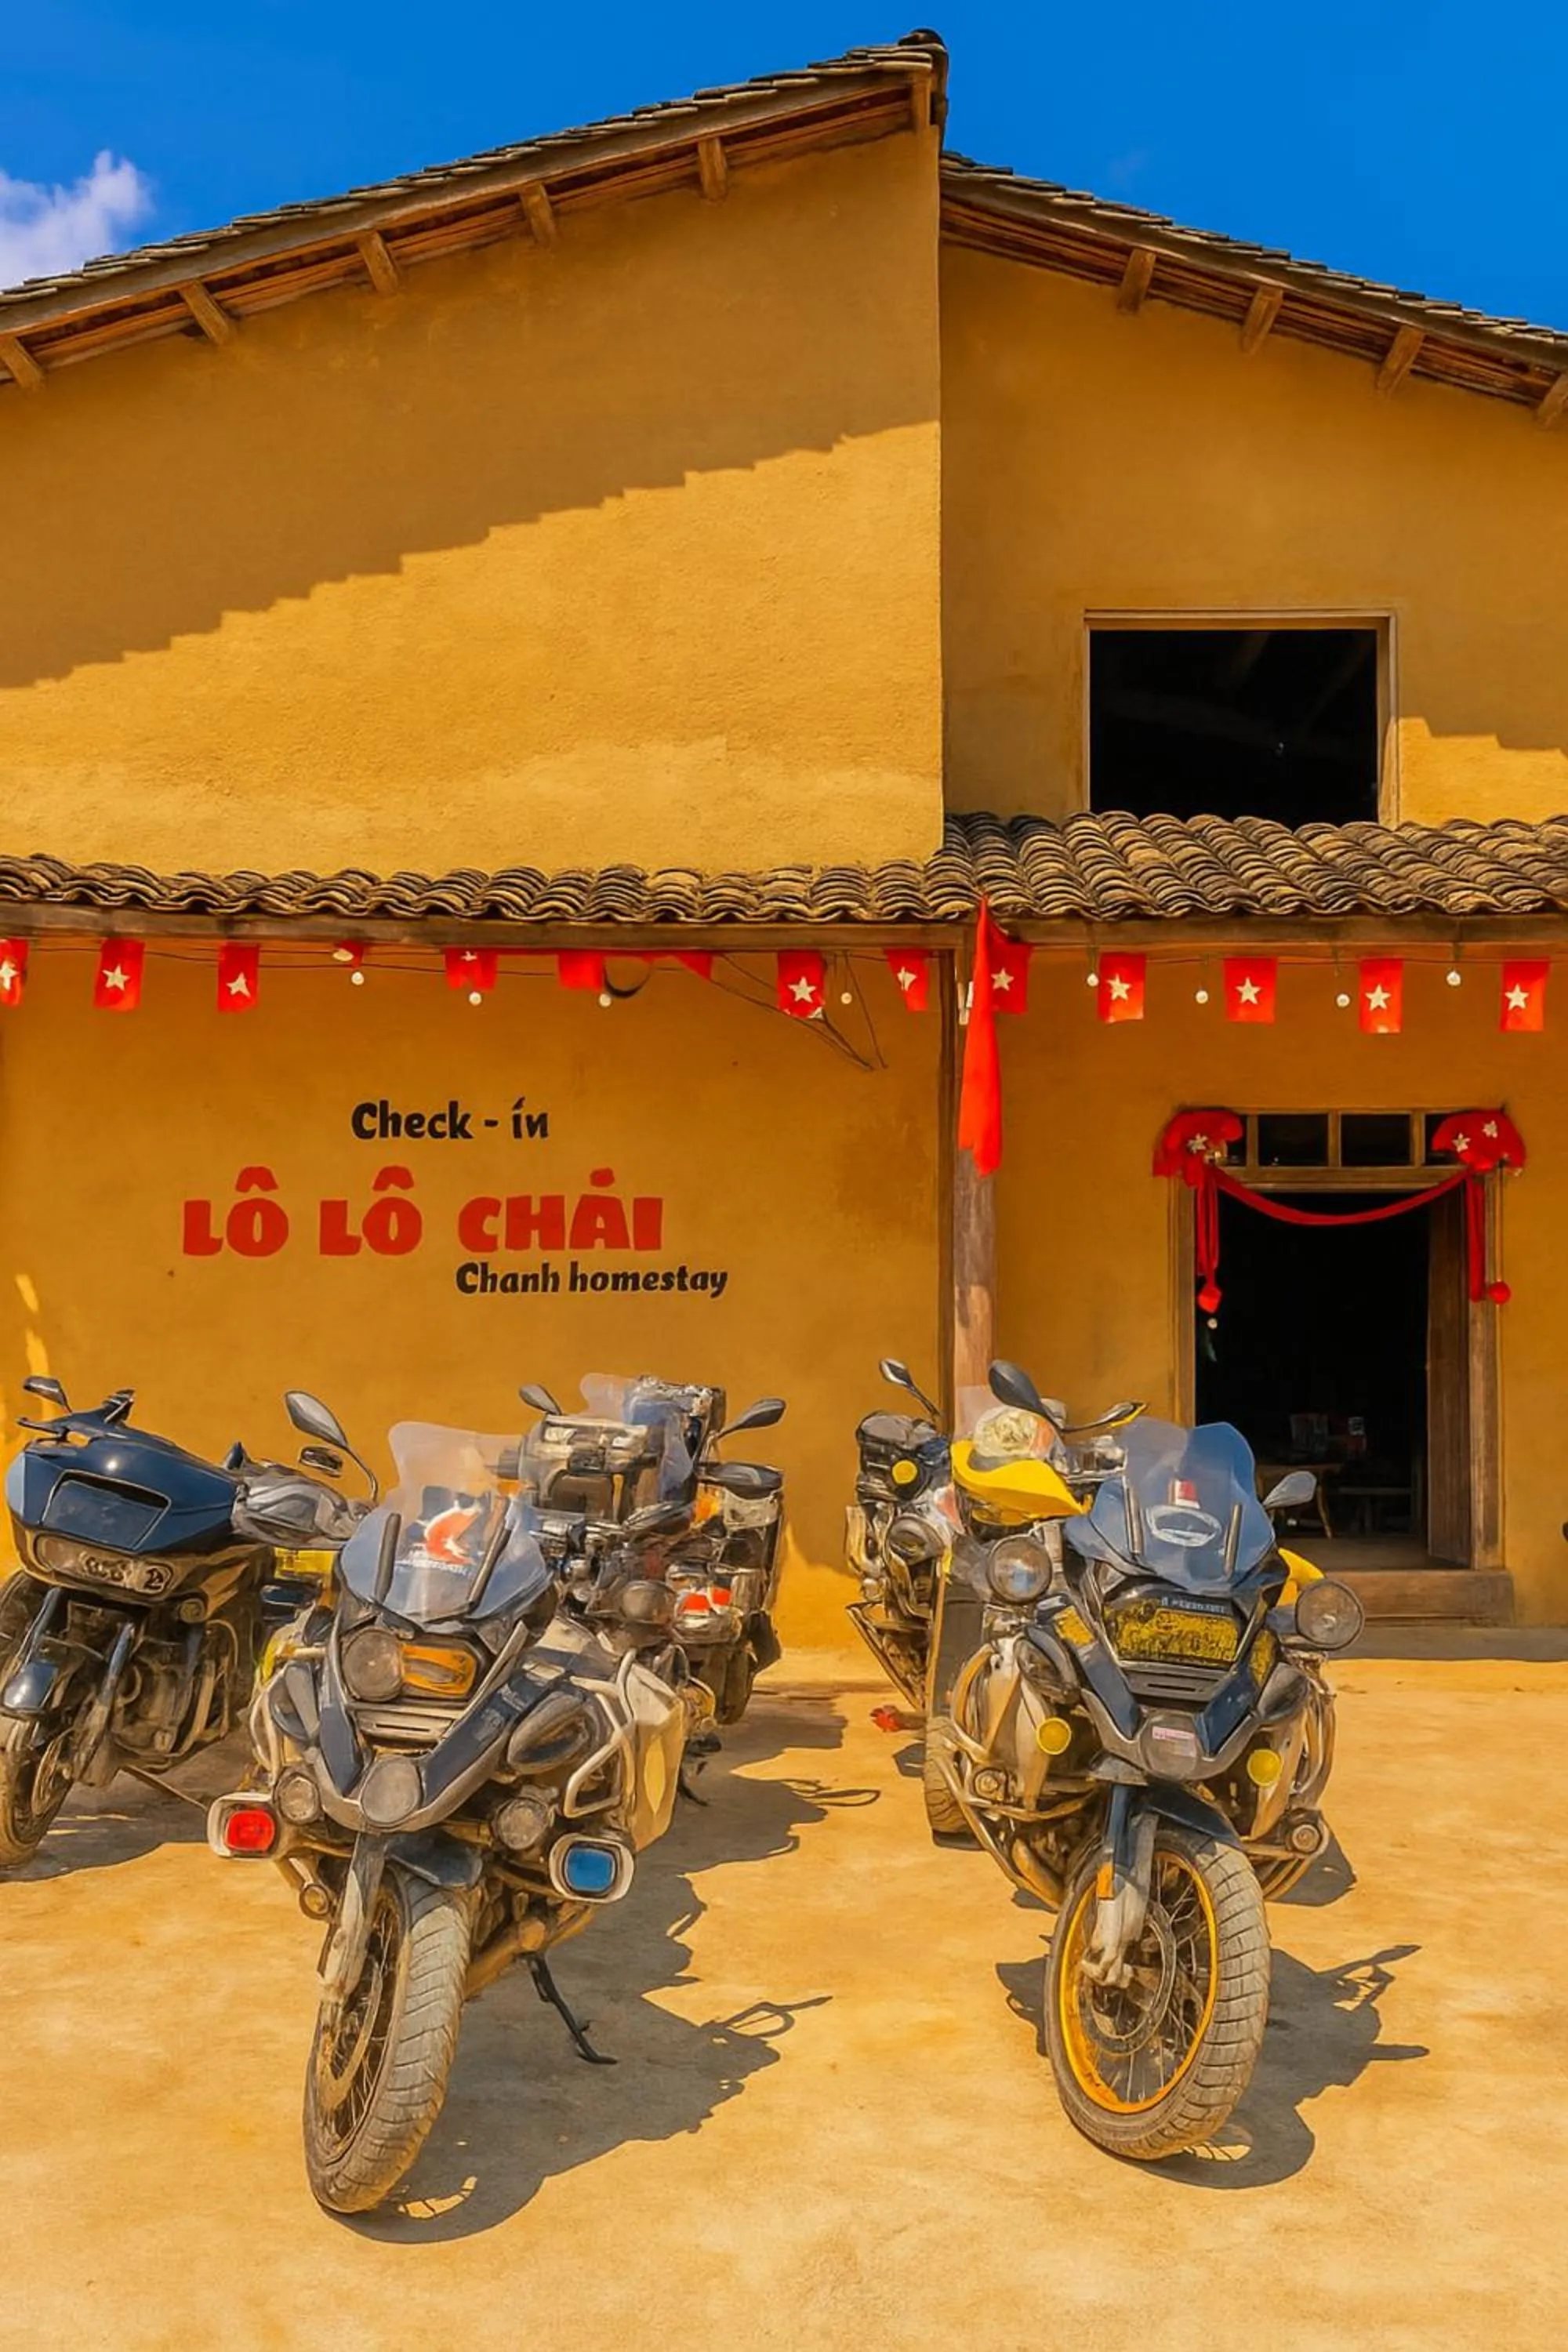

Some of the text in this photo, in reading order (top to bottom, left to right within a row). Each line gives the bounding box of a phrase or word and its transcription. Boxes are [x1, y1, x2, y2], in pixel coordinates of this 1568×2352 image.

[350, 1099, 474, 1140] Check
[183, 1166, 289, 1258] LÔ
[319, 1165, 423, 1256] LÔ
[456, 1261, 728, 1299] Chanh homestay
